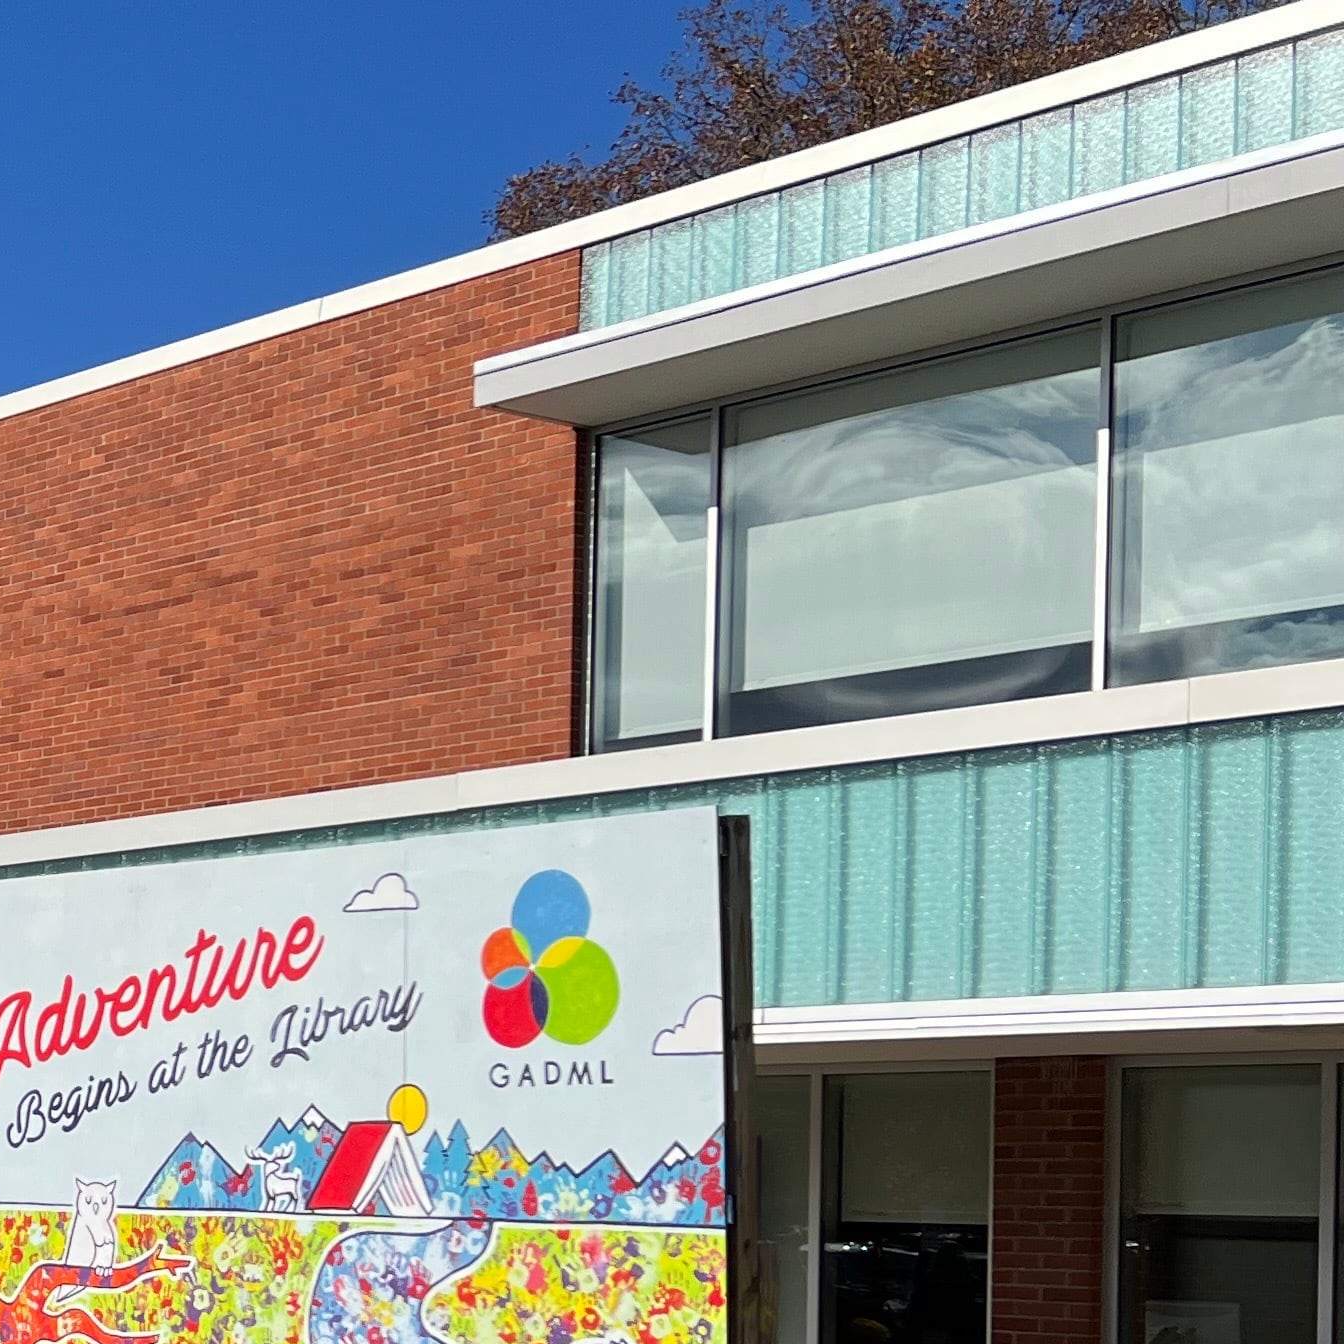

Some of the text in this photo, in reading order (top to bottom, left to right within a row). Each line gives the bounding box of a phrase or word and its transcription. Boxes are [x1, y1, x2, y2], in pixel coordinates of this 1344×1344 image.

[6, 980, 424, 1148] Begins at the Library
[489, 1060, 614, 1088] GADML
